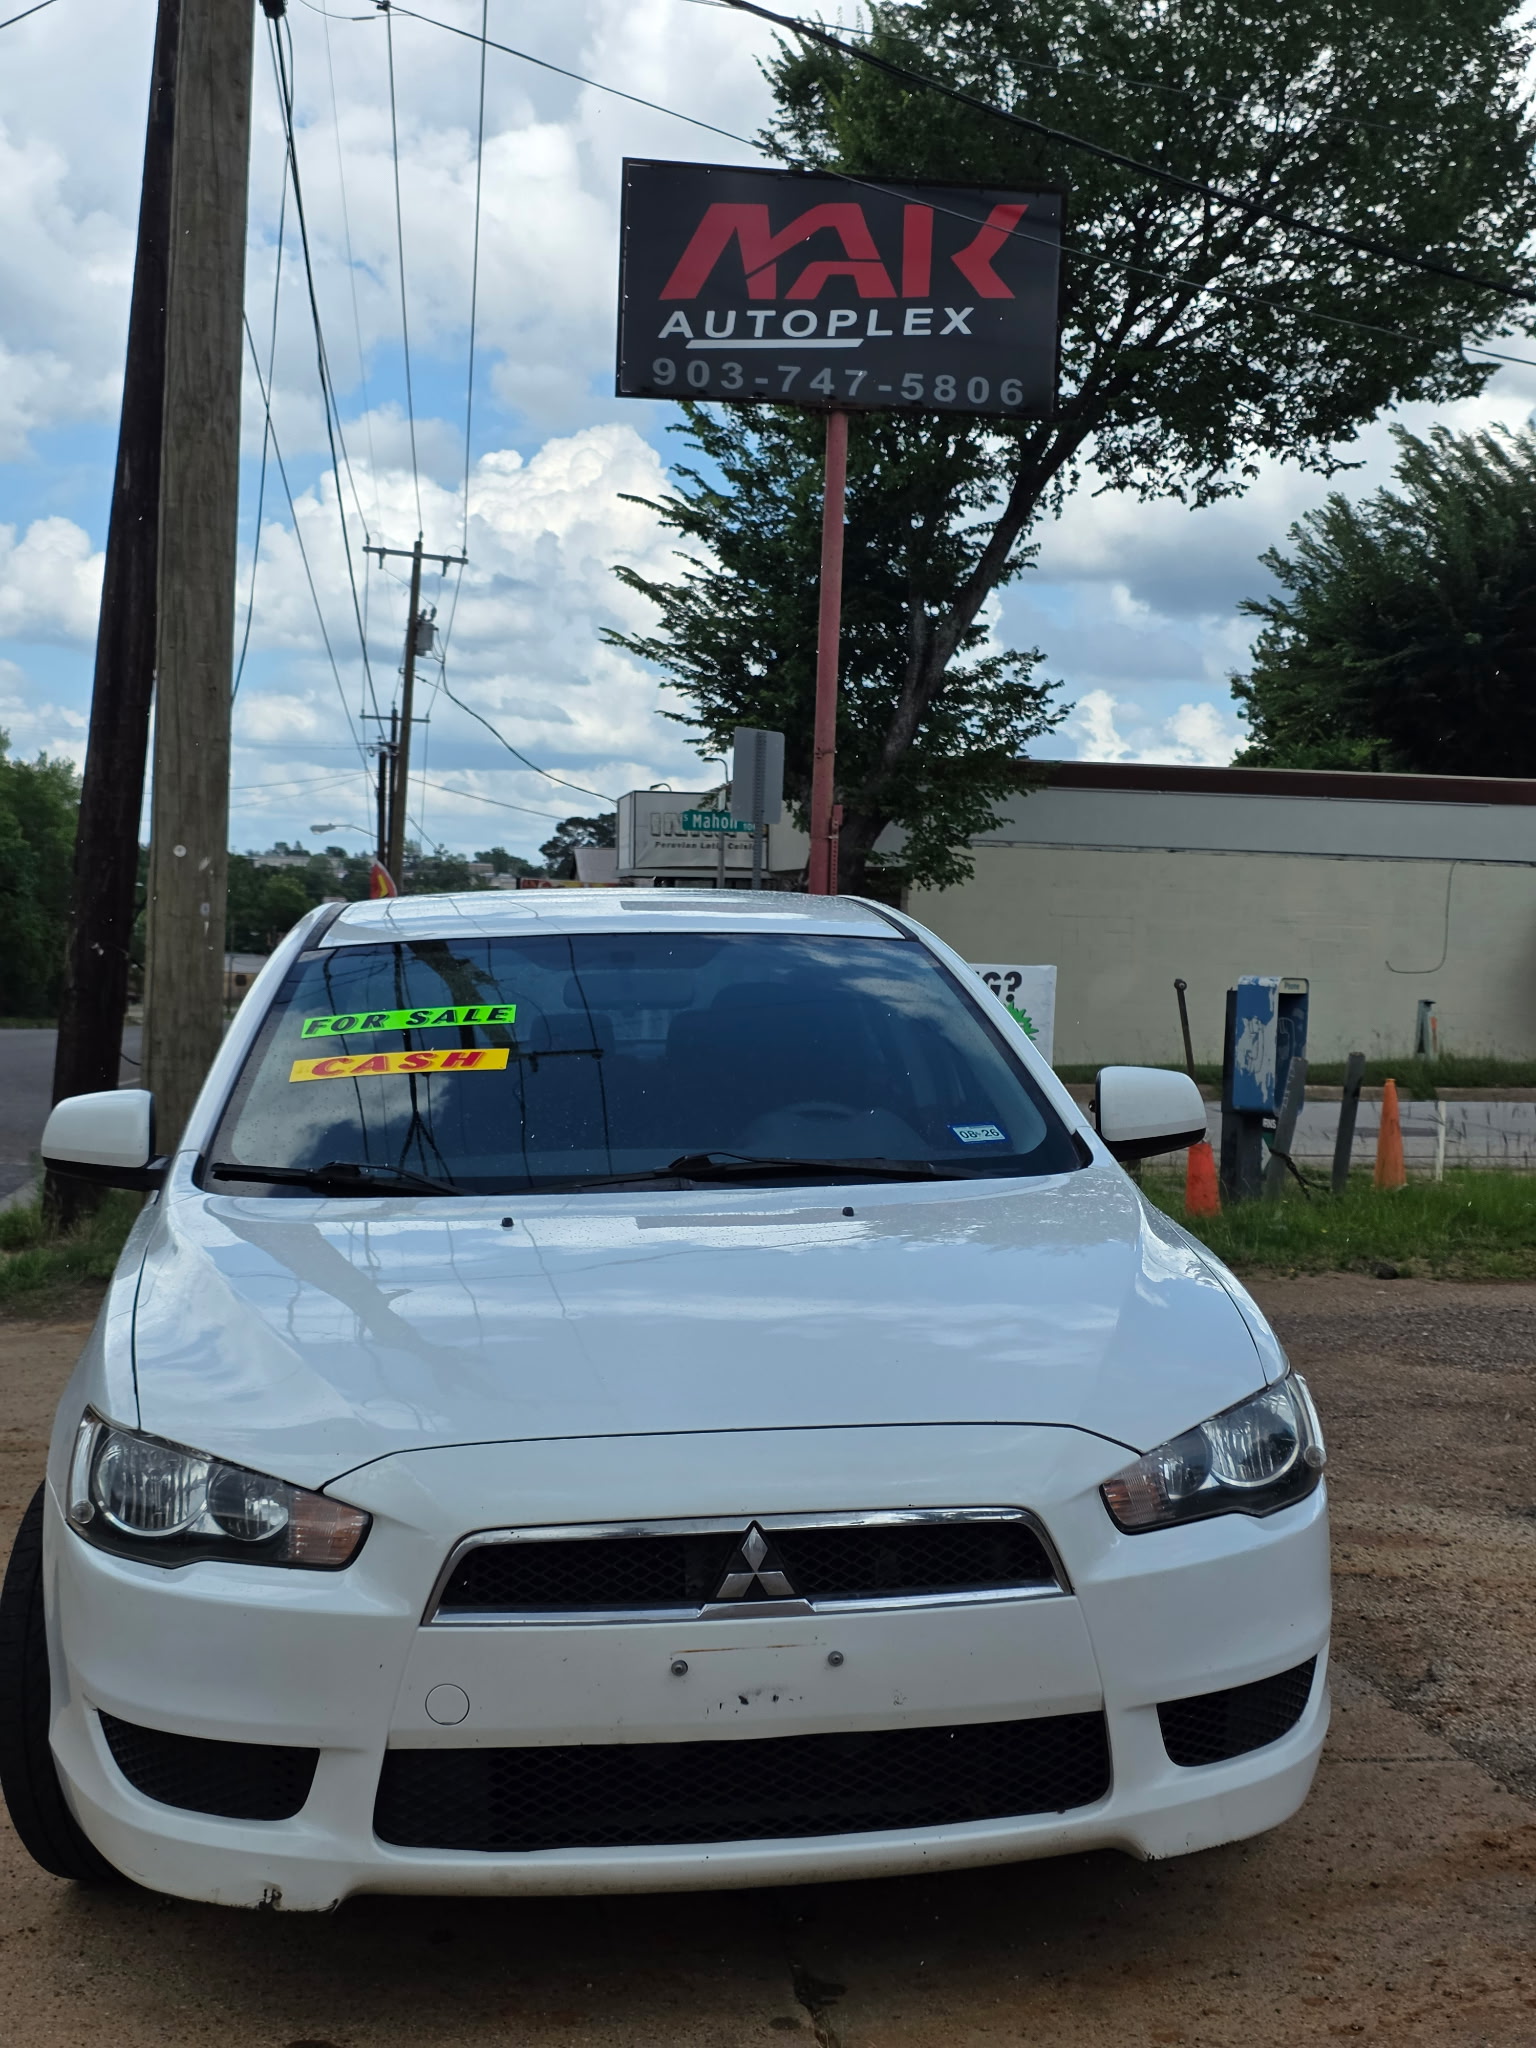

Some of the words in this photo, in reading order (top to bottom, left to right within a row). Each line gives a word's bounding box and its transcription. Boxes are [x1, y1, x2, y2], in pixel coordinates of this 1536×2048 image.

[659, 203, 1029, 299] MAK
[658, 307, 974, 338] AUTOPLEX
[652, 358, 1023, 405] 903-747-5806
[692, 814, 738, 829] Mahon
[654, 841, 697, 849] Peruvian
[700, 842, 722, 850] Lati
[728, 842, 757, 850] Cuisi
[305, 1014, 388, 1035] FOR
[406, 1007, 513, 1026] SALE
[311, 1051, 487, 1076] CASH
